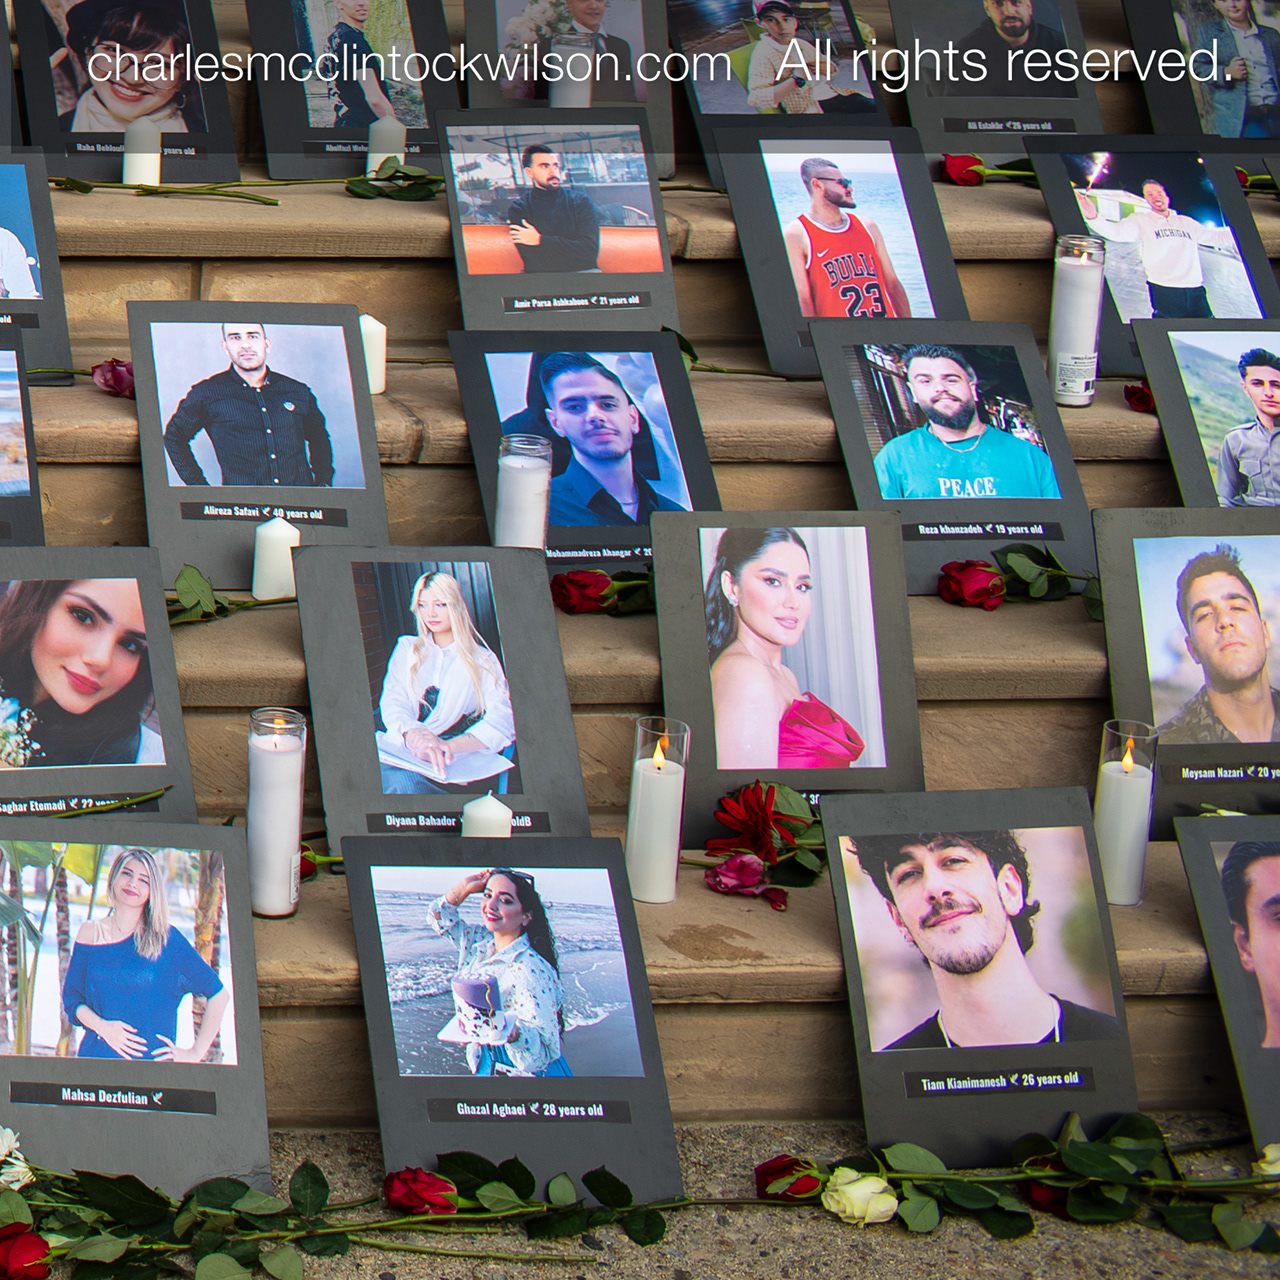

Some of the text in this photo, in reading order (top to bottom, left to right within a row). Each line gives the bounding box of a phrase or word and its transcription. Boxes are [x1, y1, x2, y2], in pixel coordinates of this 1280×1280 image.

[1154, 227, 1192, 240] MICHIGAN
[822, 252, 878, 289] BULL
[839, 281, 887, 318] 23
[938, 477, 996, 497] PEACE
[922, 1072, 1078, 1090] Tiam Kianimanesh 26 years old
[62, 1088, 147, 1104] Mahsa Dezfulian
[457, 1103, 603, 1117] Ghazal Aghaei 28 years old
